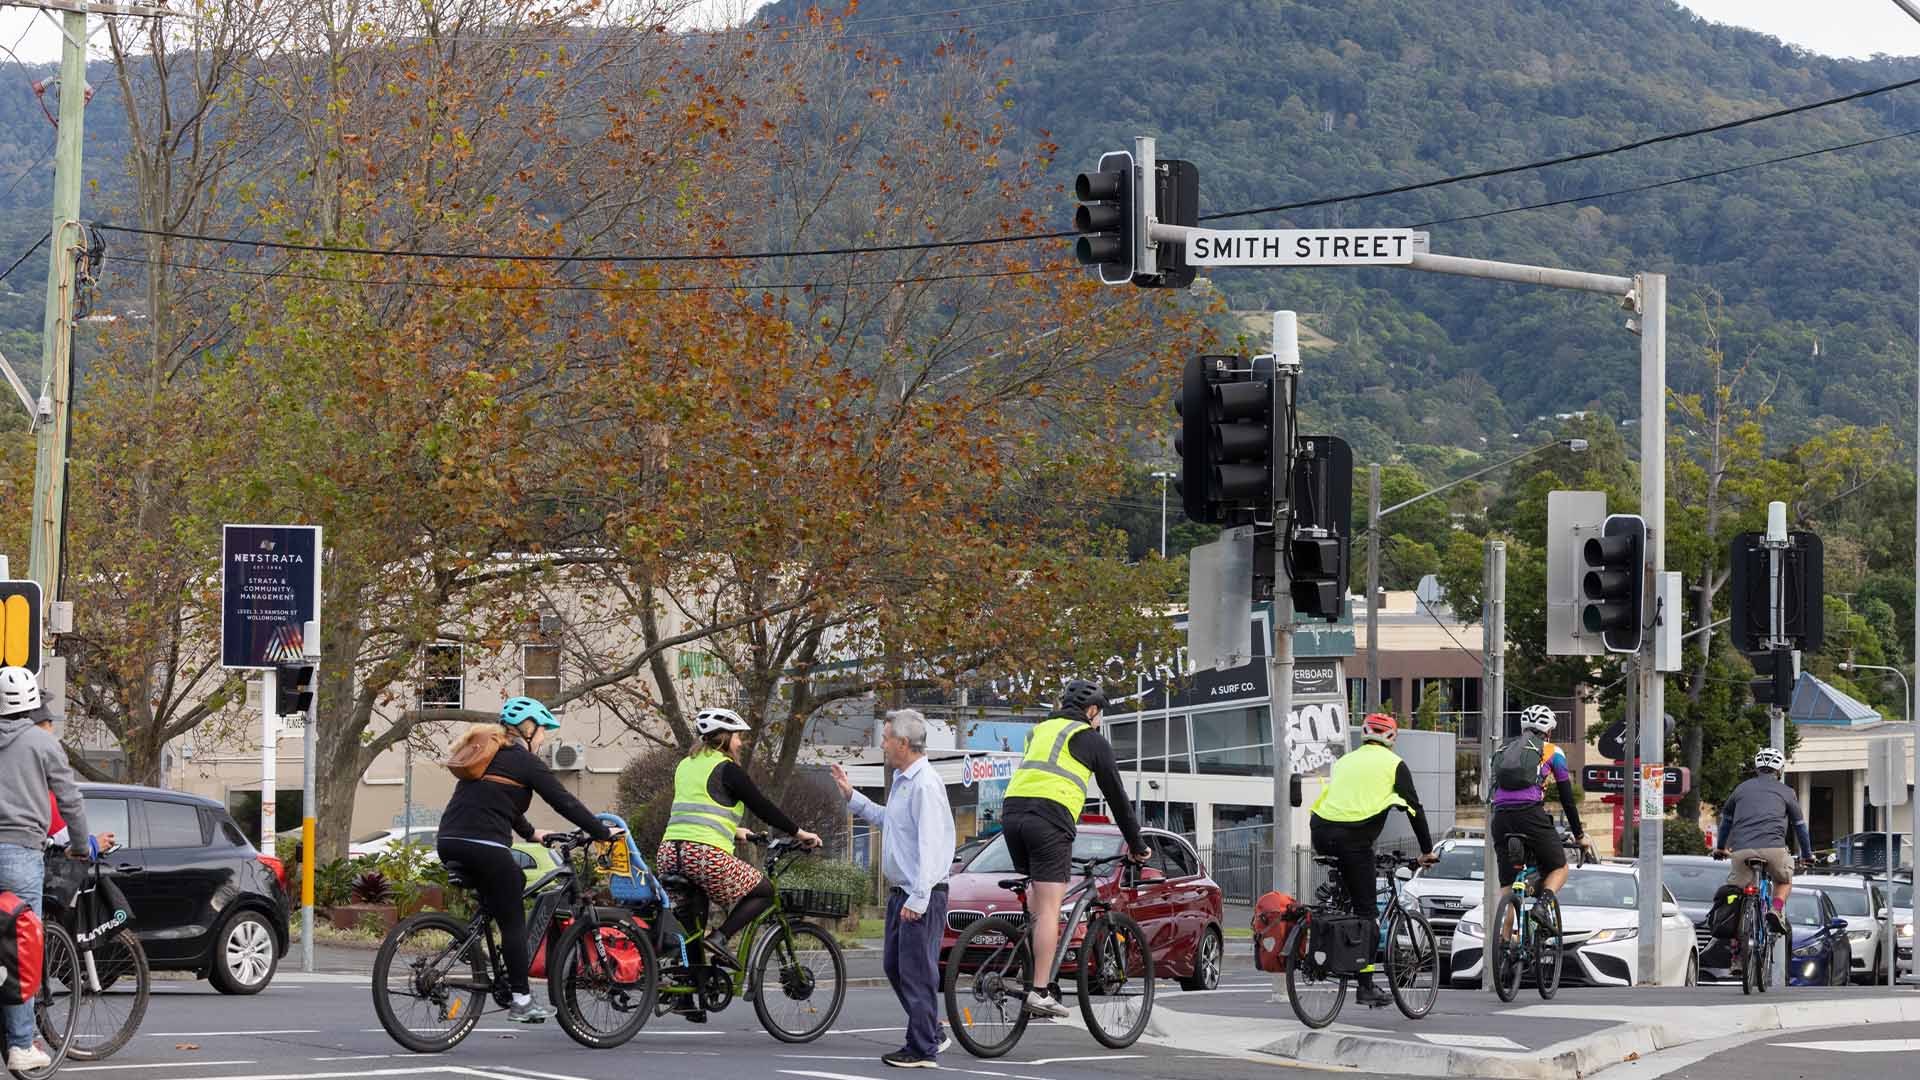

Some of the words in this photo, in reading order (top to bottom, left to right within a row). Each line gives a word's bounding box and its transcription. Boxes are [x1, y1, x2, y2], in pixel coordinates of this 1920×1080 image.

[1194, 237, 1280, 258] SMITH
[1295, 236, 1407, 257] STREET
[234, 553, 303, 563] NETSTRATA
[240, 593, 295, 601] MANAGEMENT
[1210, 687, 1218, 696] A
[1218, 683, 1240, 695] SURF
[1241, 682, 1256, 692] CO.
[972, 758, 1012, 776] Solahart
